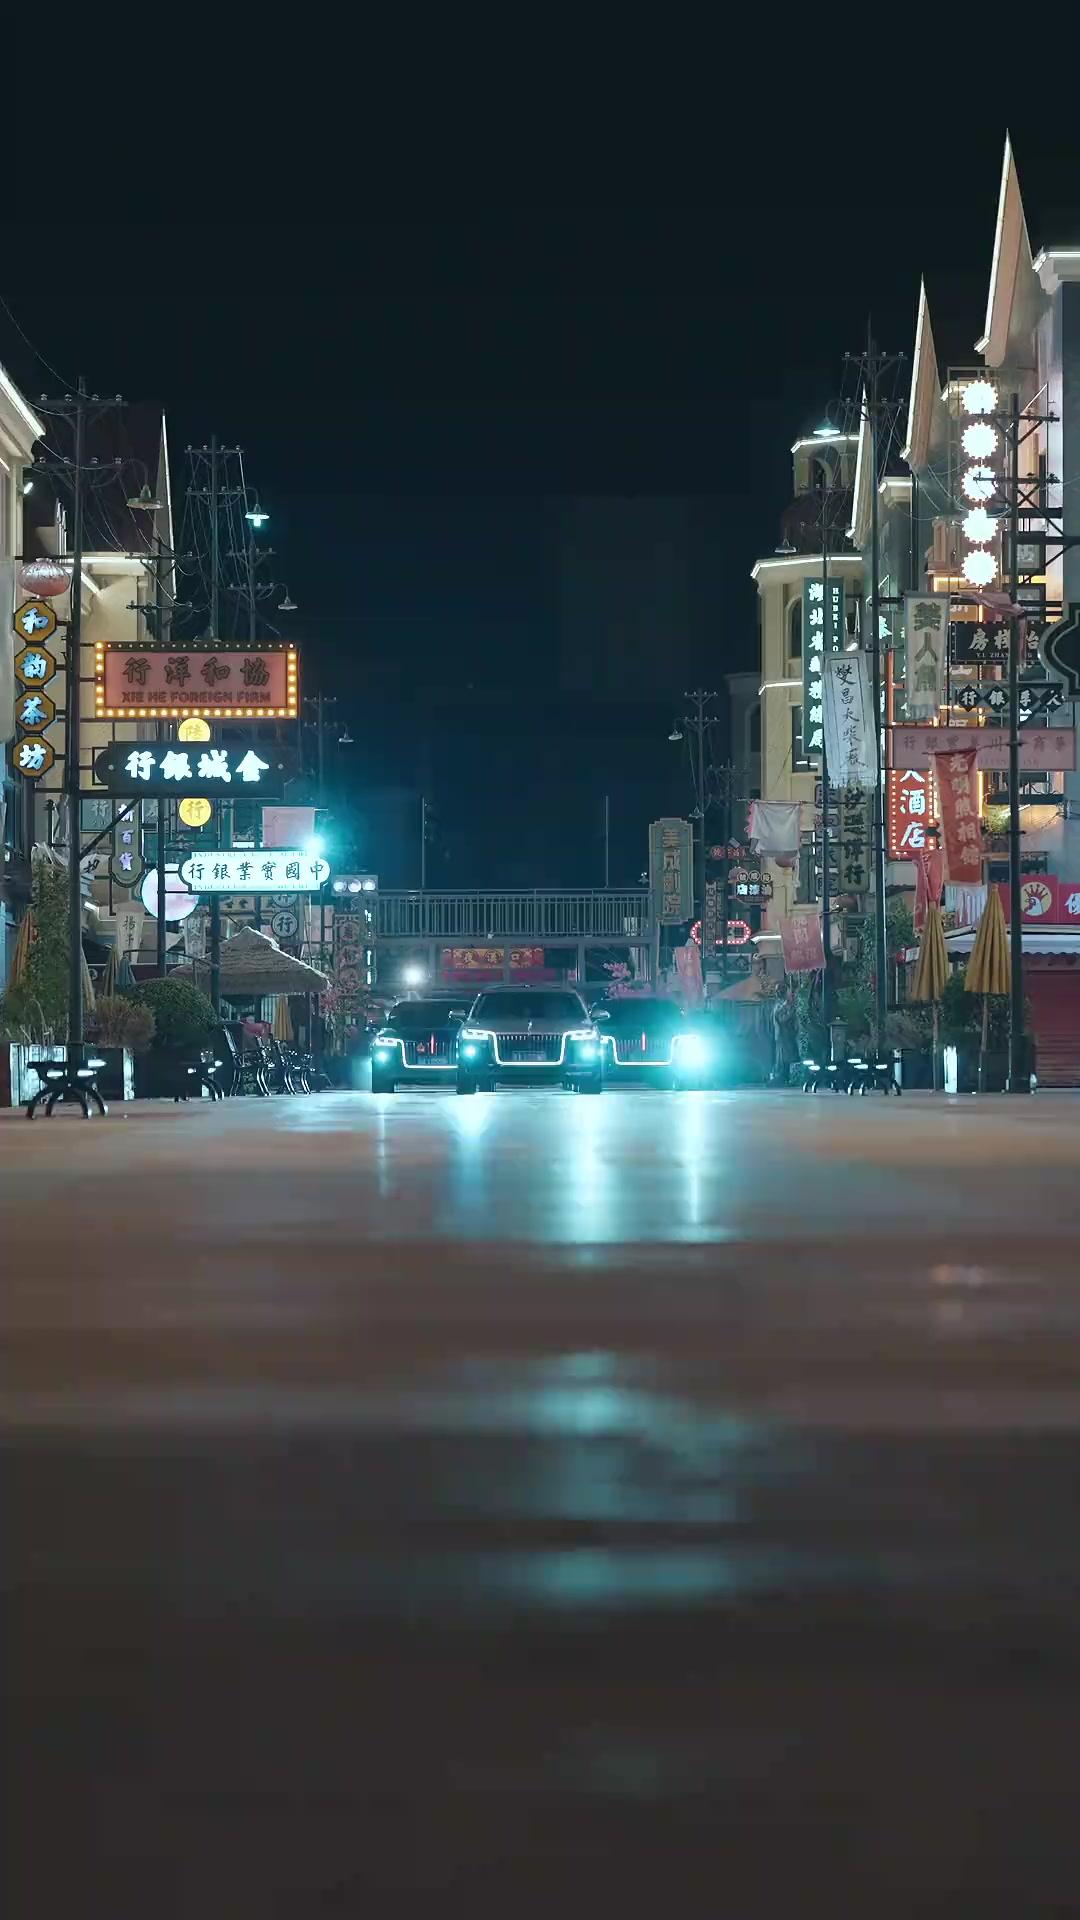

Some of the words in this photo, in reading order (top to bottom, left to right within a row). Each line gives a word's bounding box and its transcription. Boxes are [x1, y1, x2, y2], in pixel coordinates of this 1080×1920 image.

[121, 691, 145, 704] XIE
[148, 691, 167, 704] HE
[170, 691, 233, 704] FOREIGN
[236, 691, 271, 704] FIRM
